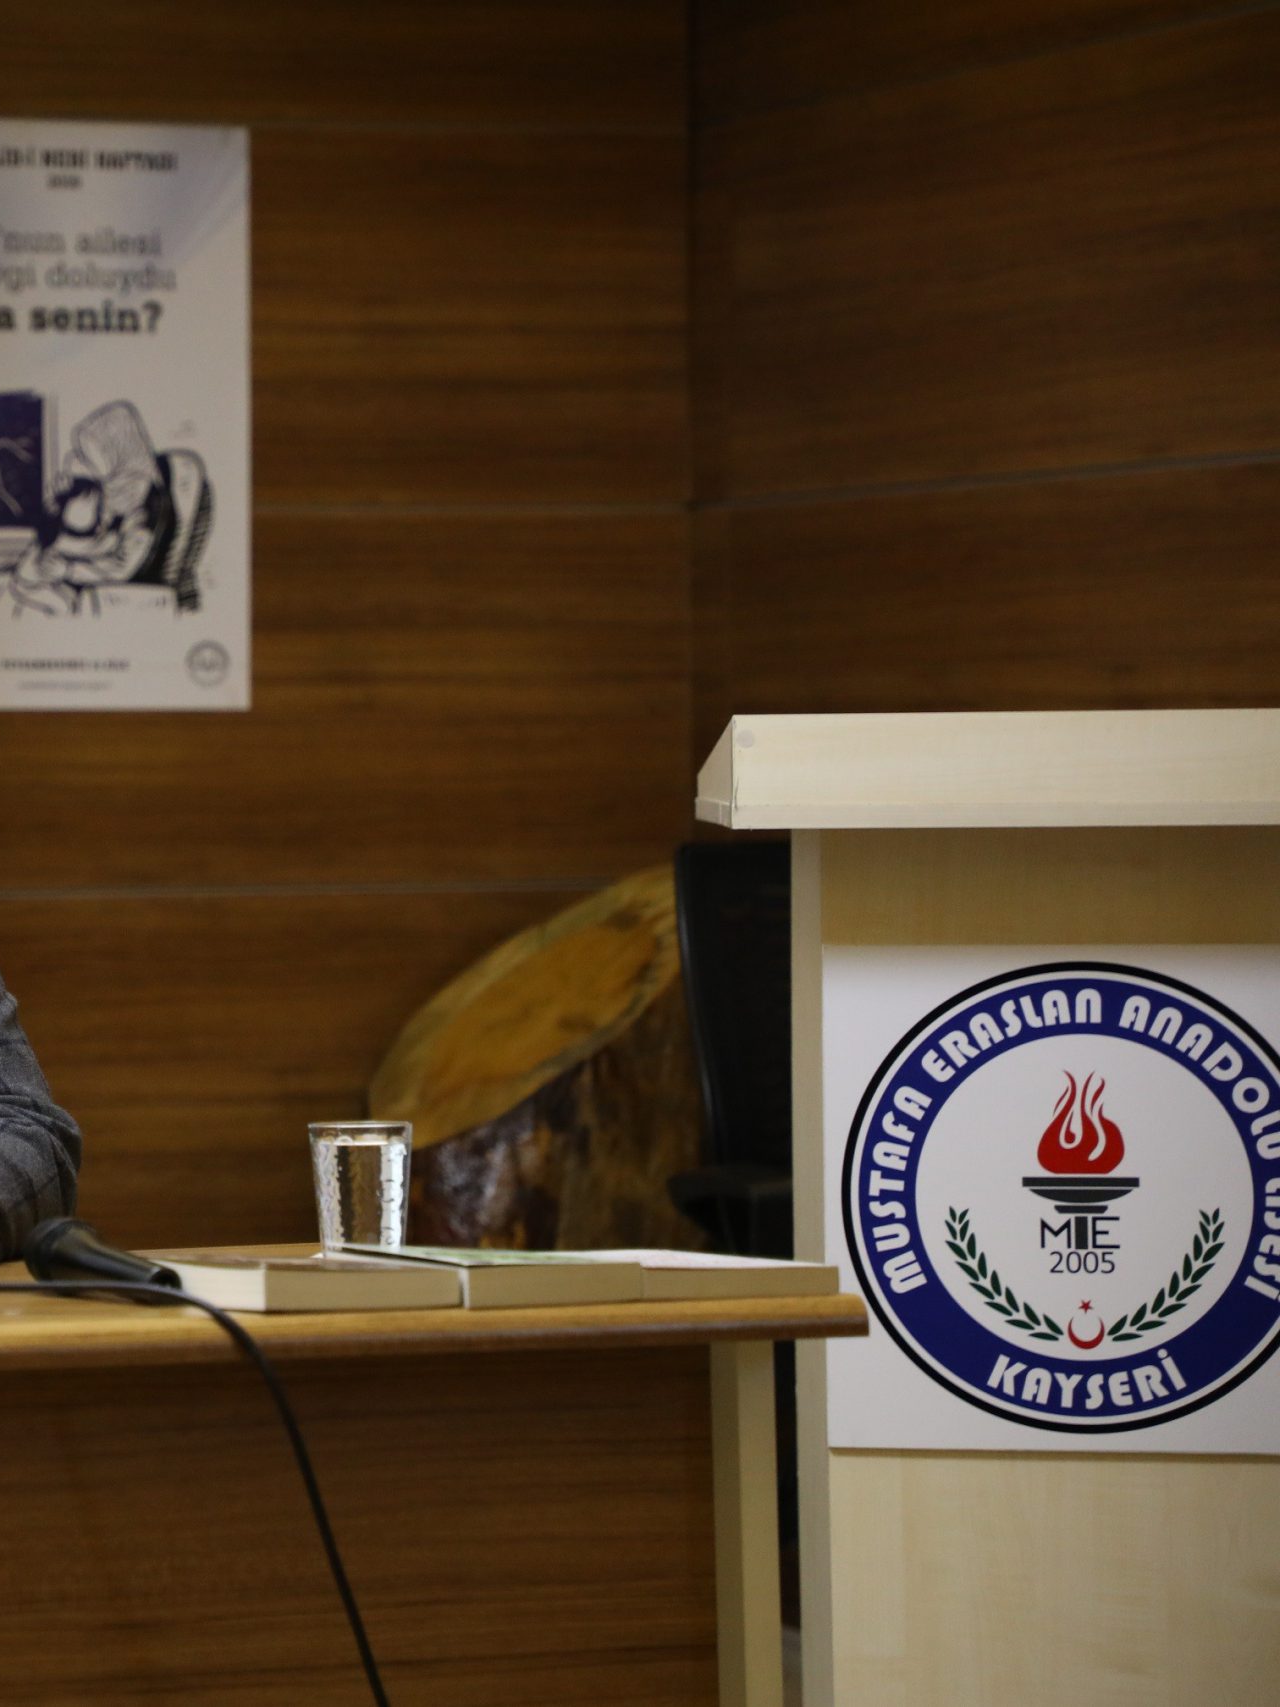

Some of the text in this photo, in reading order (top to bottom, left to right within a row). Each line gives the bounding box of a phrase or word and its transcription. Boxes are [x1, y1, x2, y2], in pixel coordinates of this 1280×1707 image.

[75, 228, 162, 256] ailesi
[45, 263, 177, 296] doluydu
[29, 299, 163, 333] senin?
[869, 1085, 933, 1295] MUSTAFA
[921, 988, 1102, 1083] ERASLAN
[1119, 995, 1280, 1160] ANADOLU
[1049, 1251, 1116, 1274] 2005
[986, 1348, 1188, 1411] KAYSERİ
